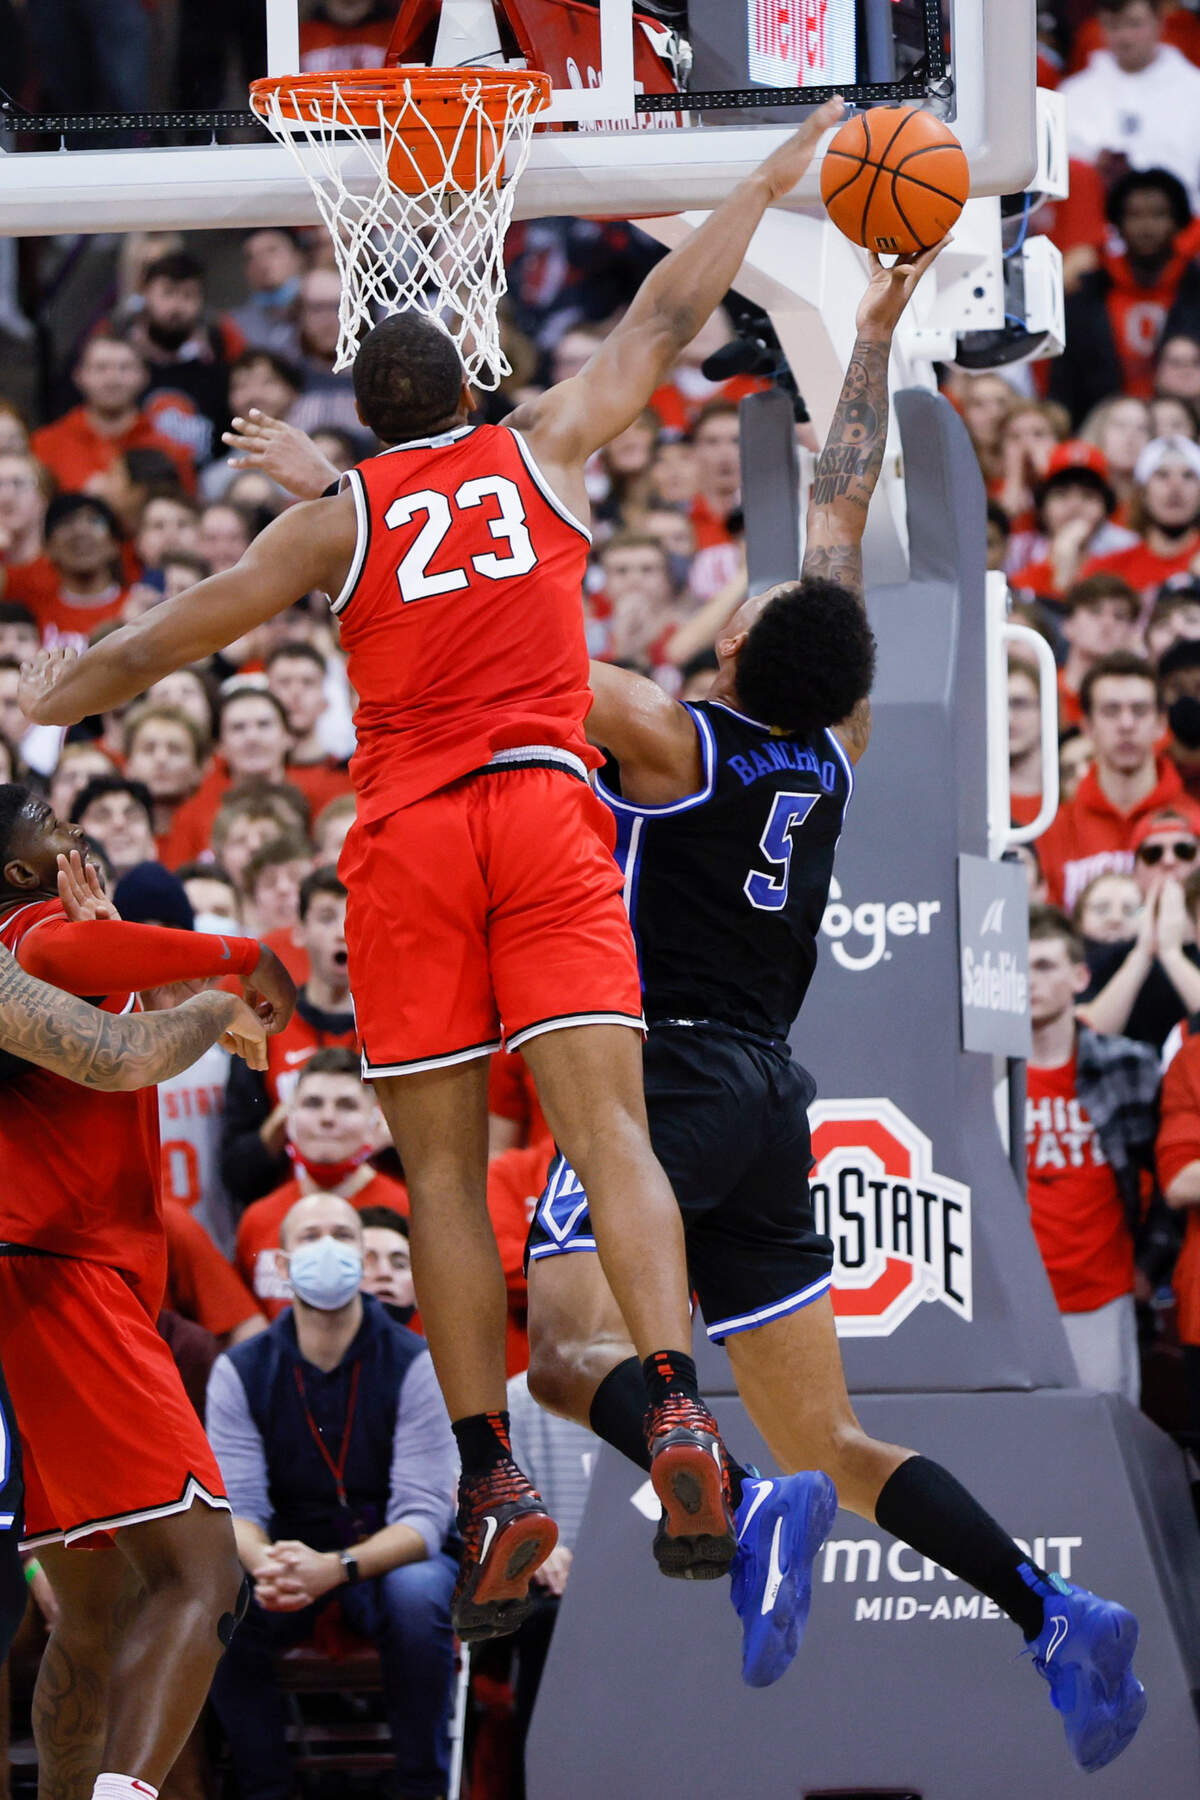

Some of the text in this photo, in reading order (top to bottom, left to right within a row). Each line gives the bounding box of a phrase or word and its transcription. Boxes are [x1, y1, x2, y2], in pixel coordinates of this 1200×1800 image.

[384, 474, 539, 604] 23
[726, 740, 836, 793] BANCHO
[743, 791, 822, 911] 5
[821, 875, 941, 971] oger
[963, 946, 1028, 1016] Safelite
